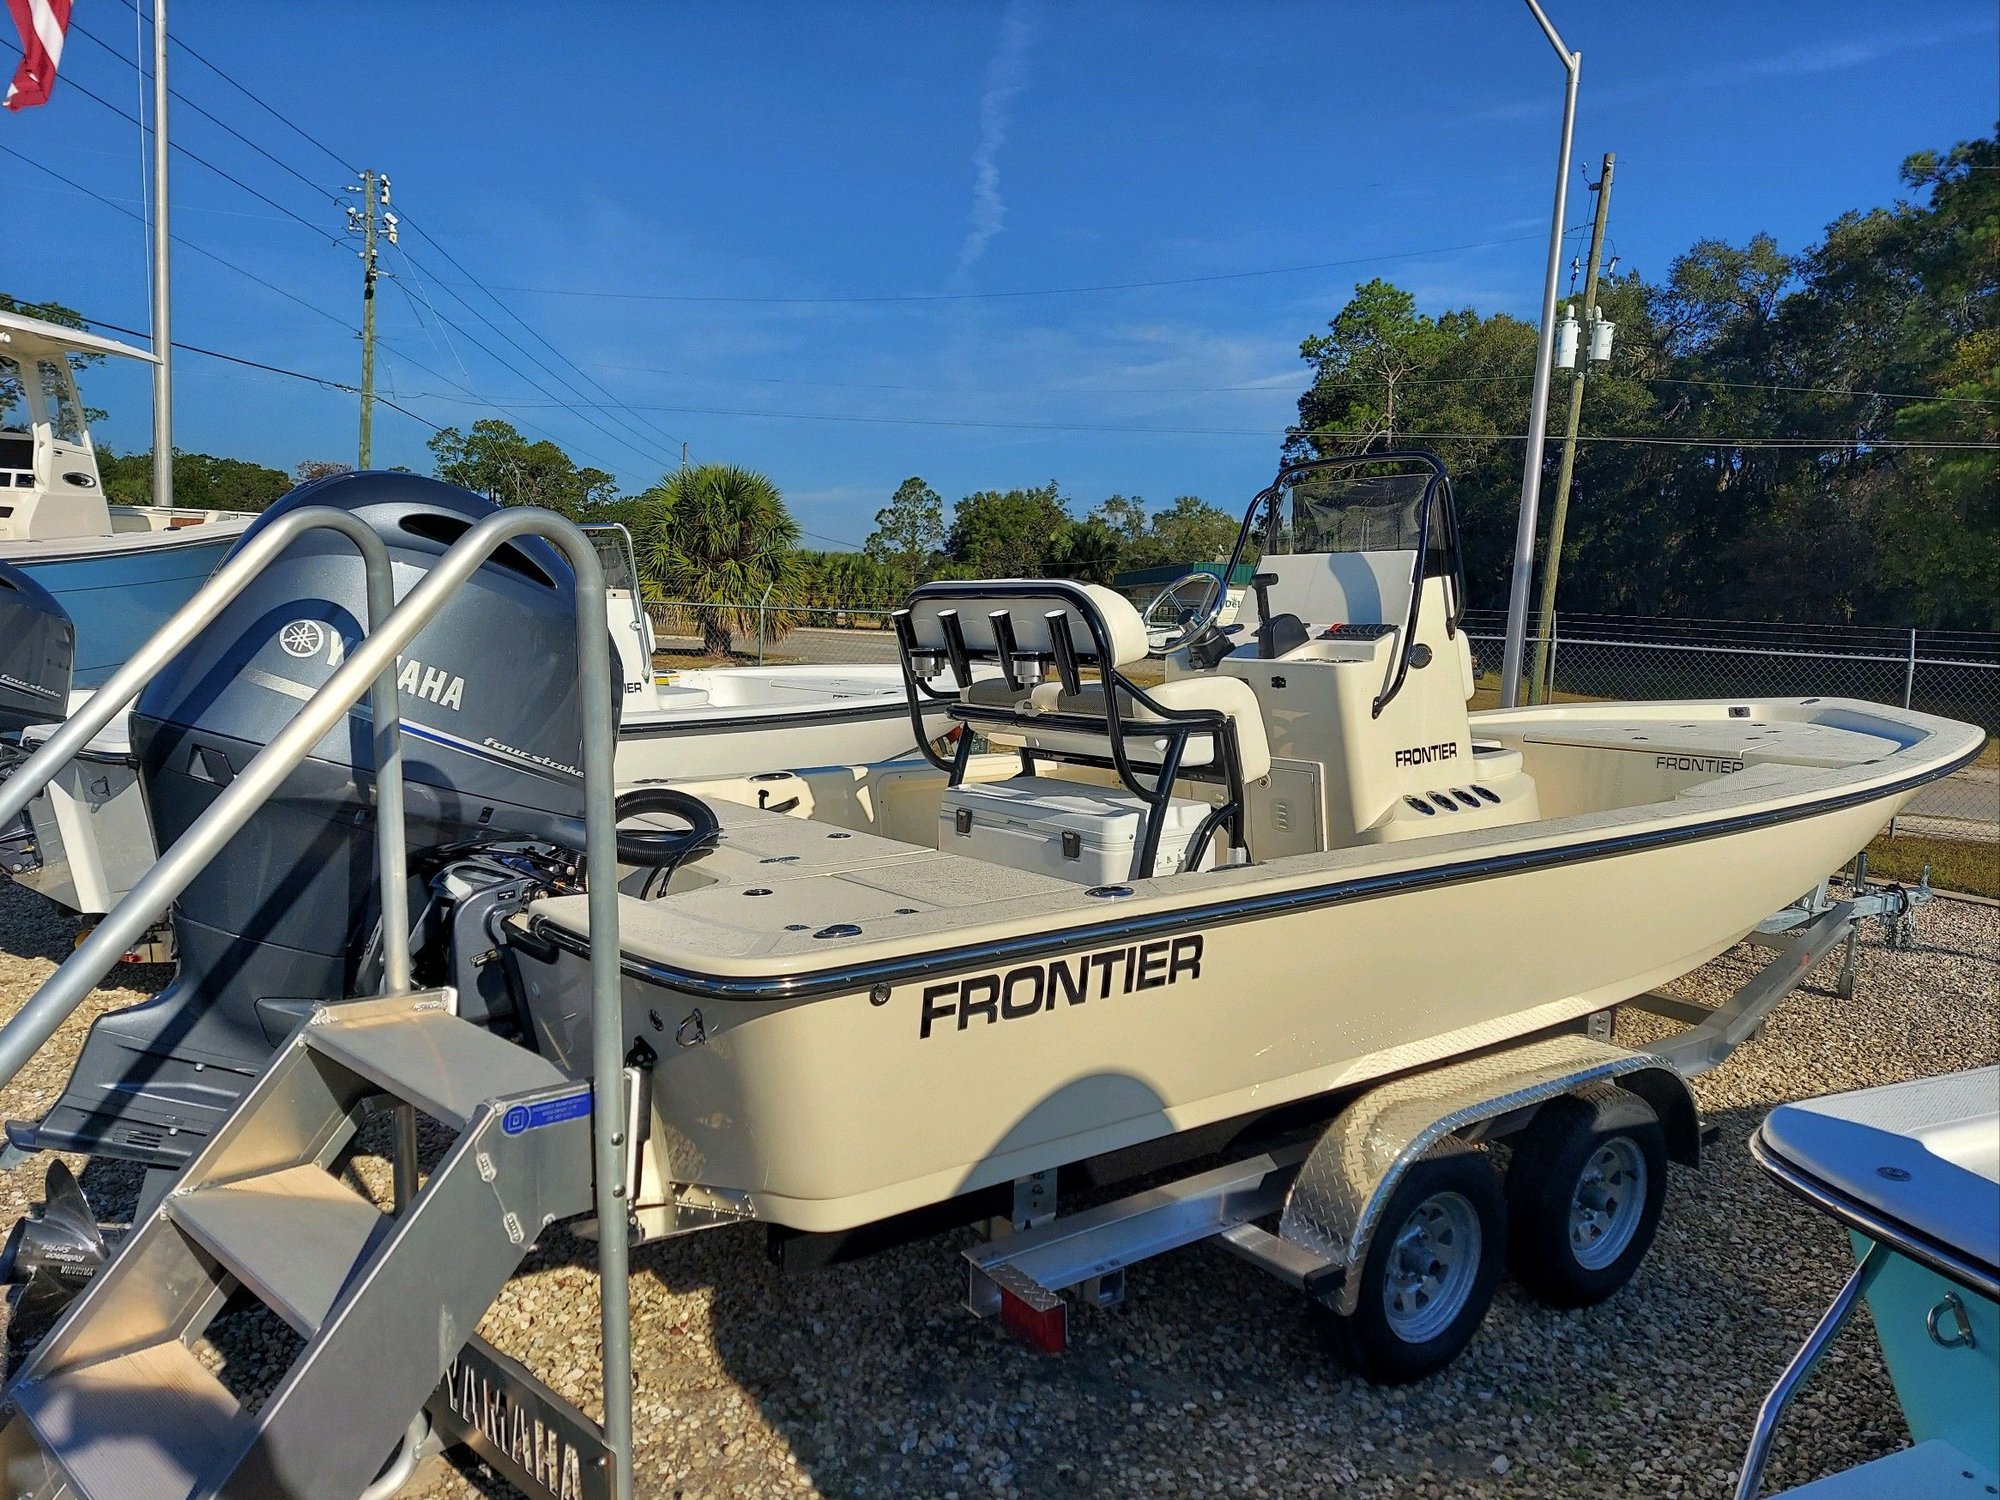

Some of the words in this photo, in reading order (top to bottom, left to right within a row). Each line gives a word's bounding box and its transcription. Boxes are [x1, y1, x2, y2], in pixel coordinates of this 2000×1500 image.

[327, 631, 465, 711] YAHA
[1395, 742, 1457, 768] FRONTIER
[920, 934, 1204, 1039] FRONTIER
[60, 1265, 94, 1277] YAMAHA
[445, 1356, 583, 1500] YAMAHA
